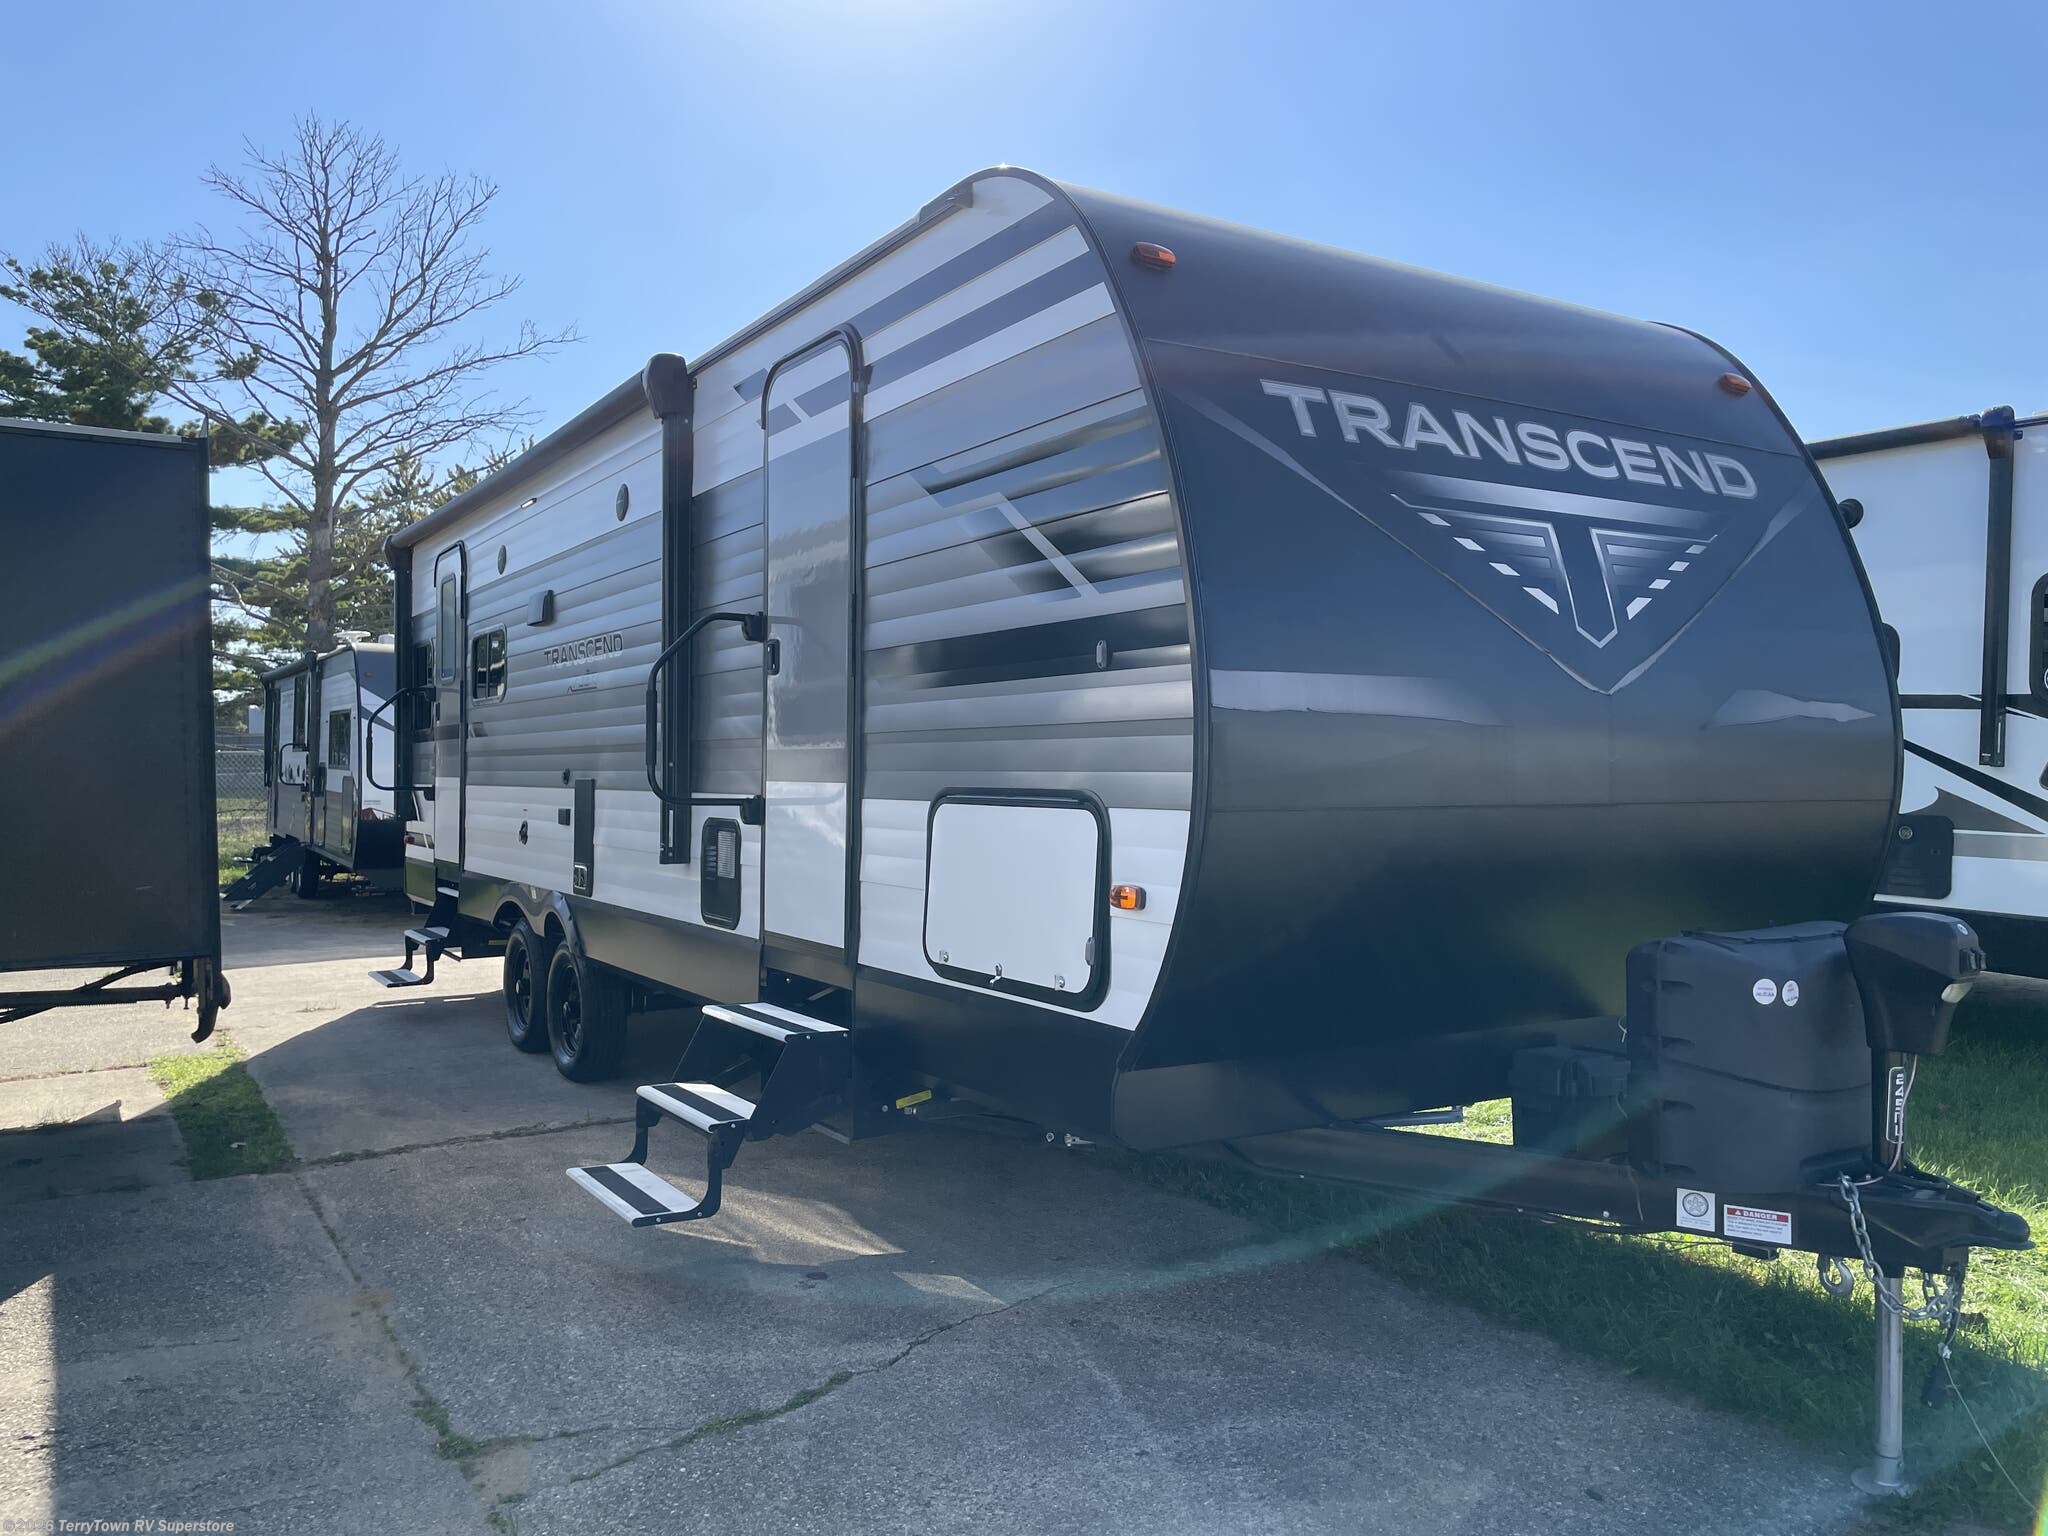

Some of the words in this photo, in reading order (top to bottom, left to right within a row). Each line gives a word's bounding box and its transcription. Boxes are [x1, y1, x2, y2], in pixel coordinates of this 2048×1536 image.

[1260, 379, 1758, 500] TRANSCEND
[543, 632, 623, 667] TRANSCEND
[1743, 1210, 1778, 1220] DANGER
